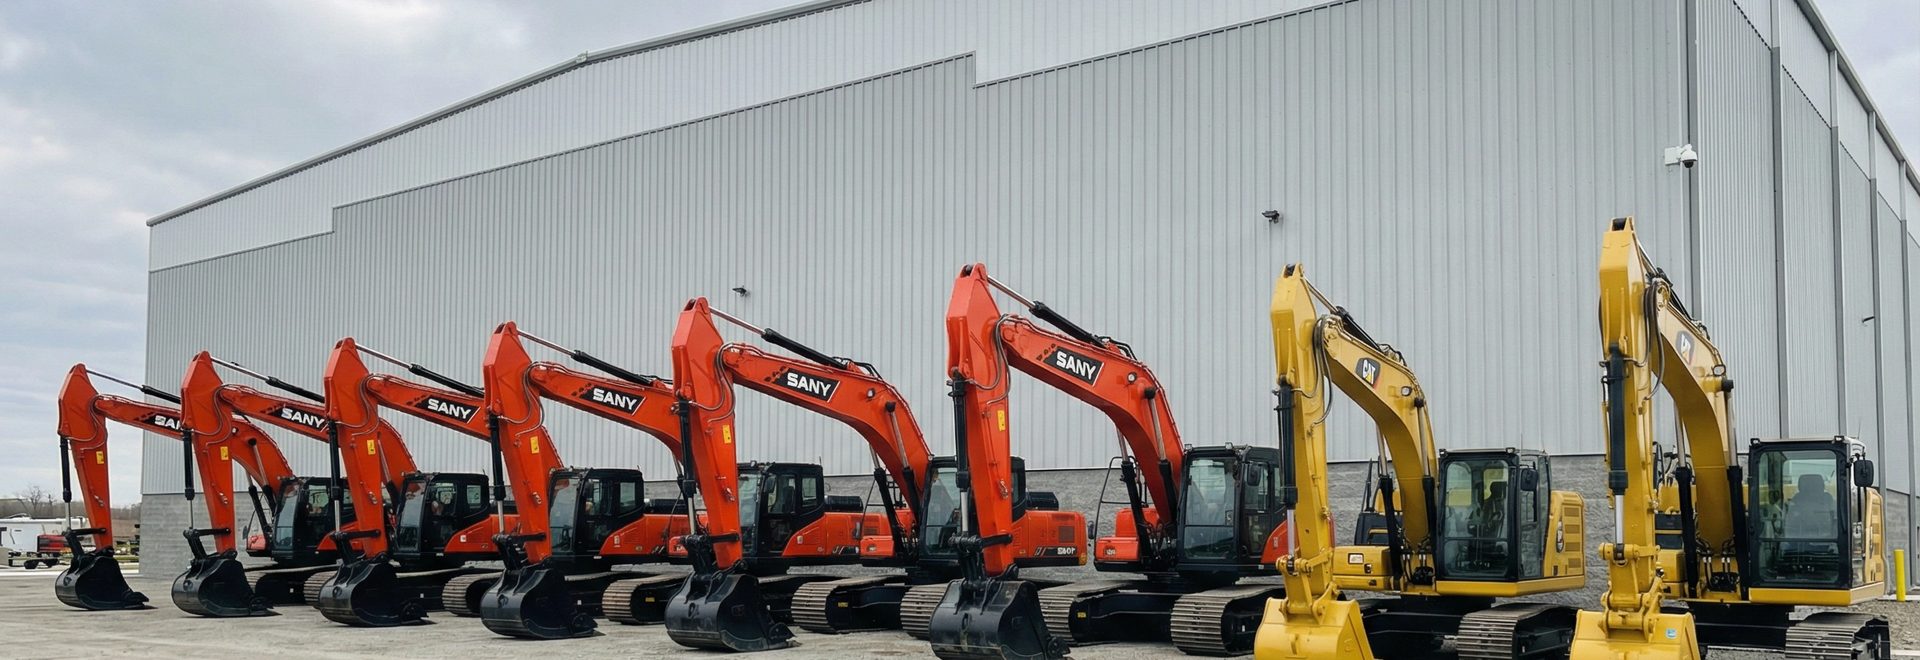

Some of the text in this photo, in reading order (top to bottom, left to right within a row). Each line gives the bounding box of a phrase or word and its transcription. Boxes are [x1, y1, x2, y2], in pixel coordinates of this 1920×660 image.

[1056, 350, 1096, 380] SANY
[787, 372, 831, 397] SANY
[427, 398, 472, 419] SANY
[593, 387, 638, 410] SANY
[281, 407, 325, 428] SANY
